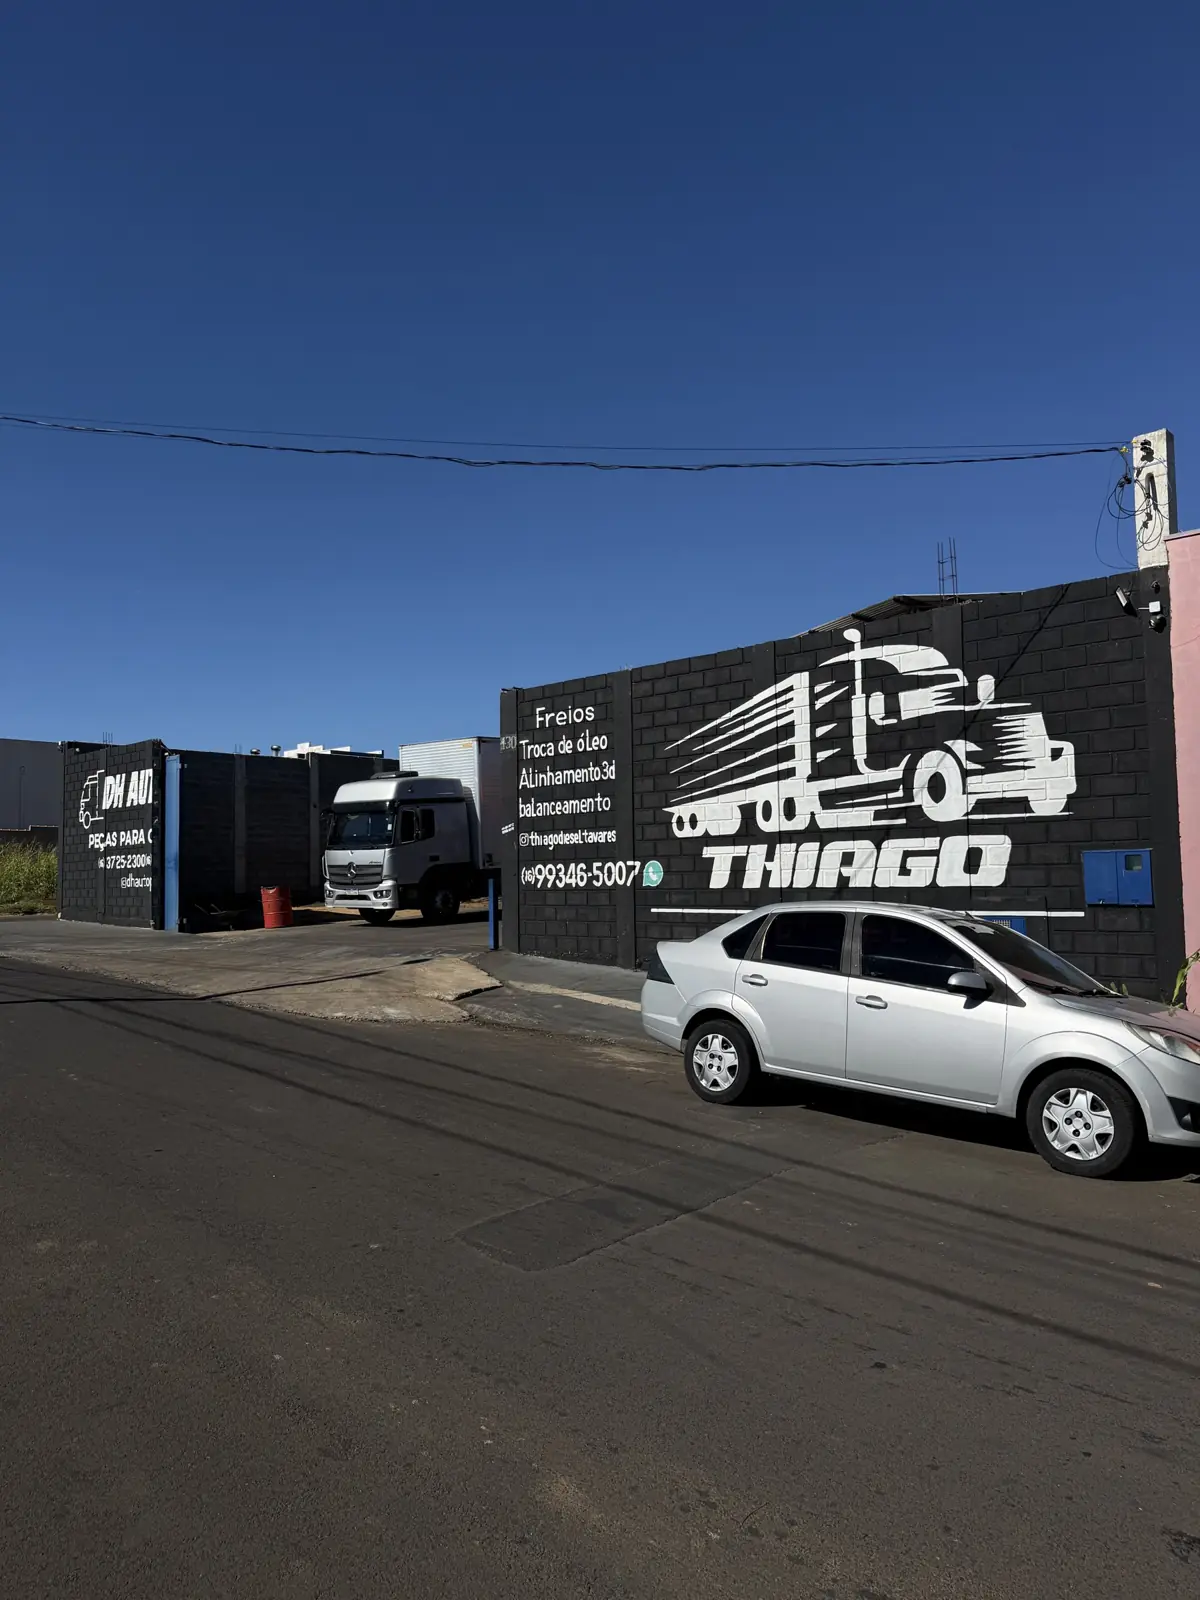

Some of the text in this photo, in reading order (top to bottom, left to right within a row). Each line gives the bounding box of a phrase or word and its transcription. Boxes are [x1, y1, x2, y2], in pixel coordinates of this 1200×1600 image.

[536, 705, 595, 728] Freios
[519, 739, 555, 760] Troca
[558, 734, 573, 754] de
[88, 831, 118, 852] PEÇAS
[119, 828, 146, 846] PARA
[702, 834, 1012, 888] THIAGO
